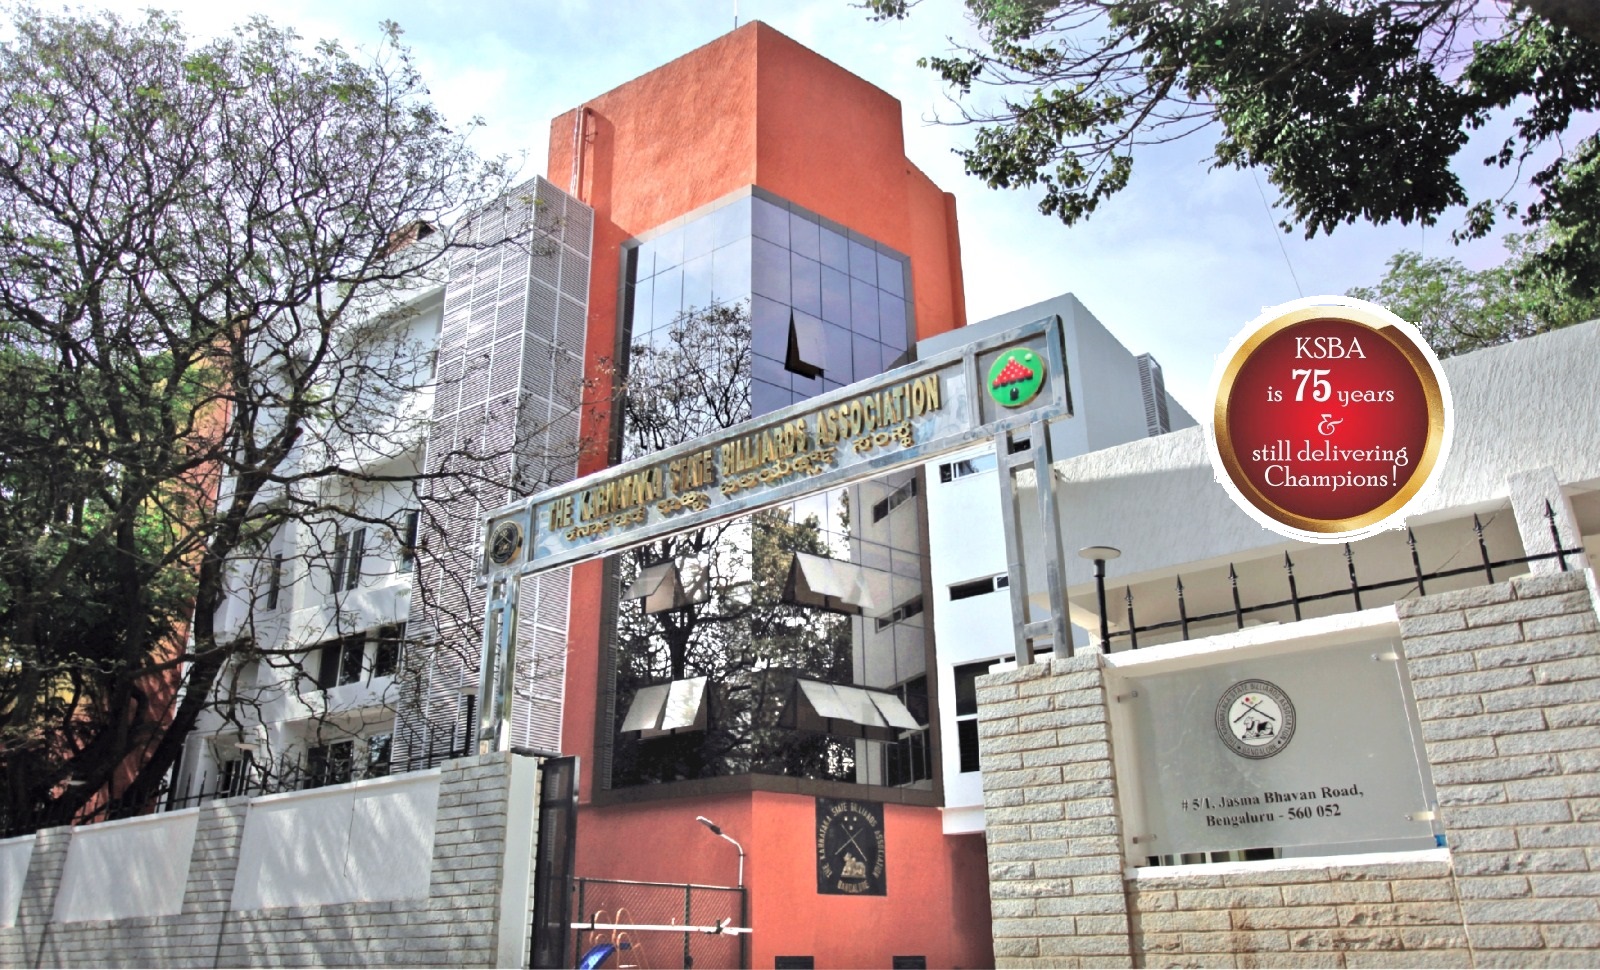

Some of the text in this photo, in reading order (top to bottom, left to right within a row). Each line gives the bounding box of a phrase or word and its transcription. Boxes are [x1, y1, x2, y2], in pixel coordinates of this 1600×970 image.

[549, 373, 942, 531] THE KARNATAKA STATE BILLIARDS ASSOCIATION
[1181, 801, 1189, 811] #
[1218, 795, 1260, 809] Jasma
[1264, 790, 1316, 804] Bhavan
[1321, 784, 1364, 798] Road,
[1206, 812, 1274, 828] Bengaluru
[1288, 806, 1312, 820] 560
[1316, 803, 1341, 818] 052
